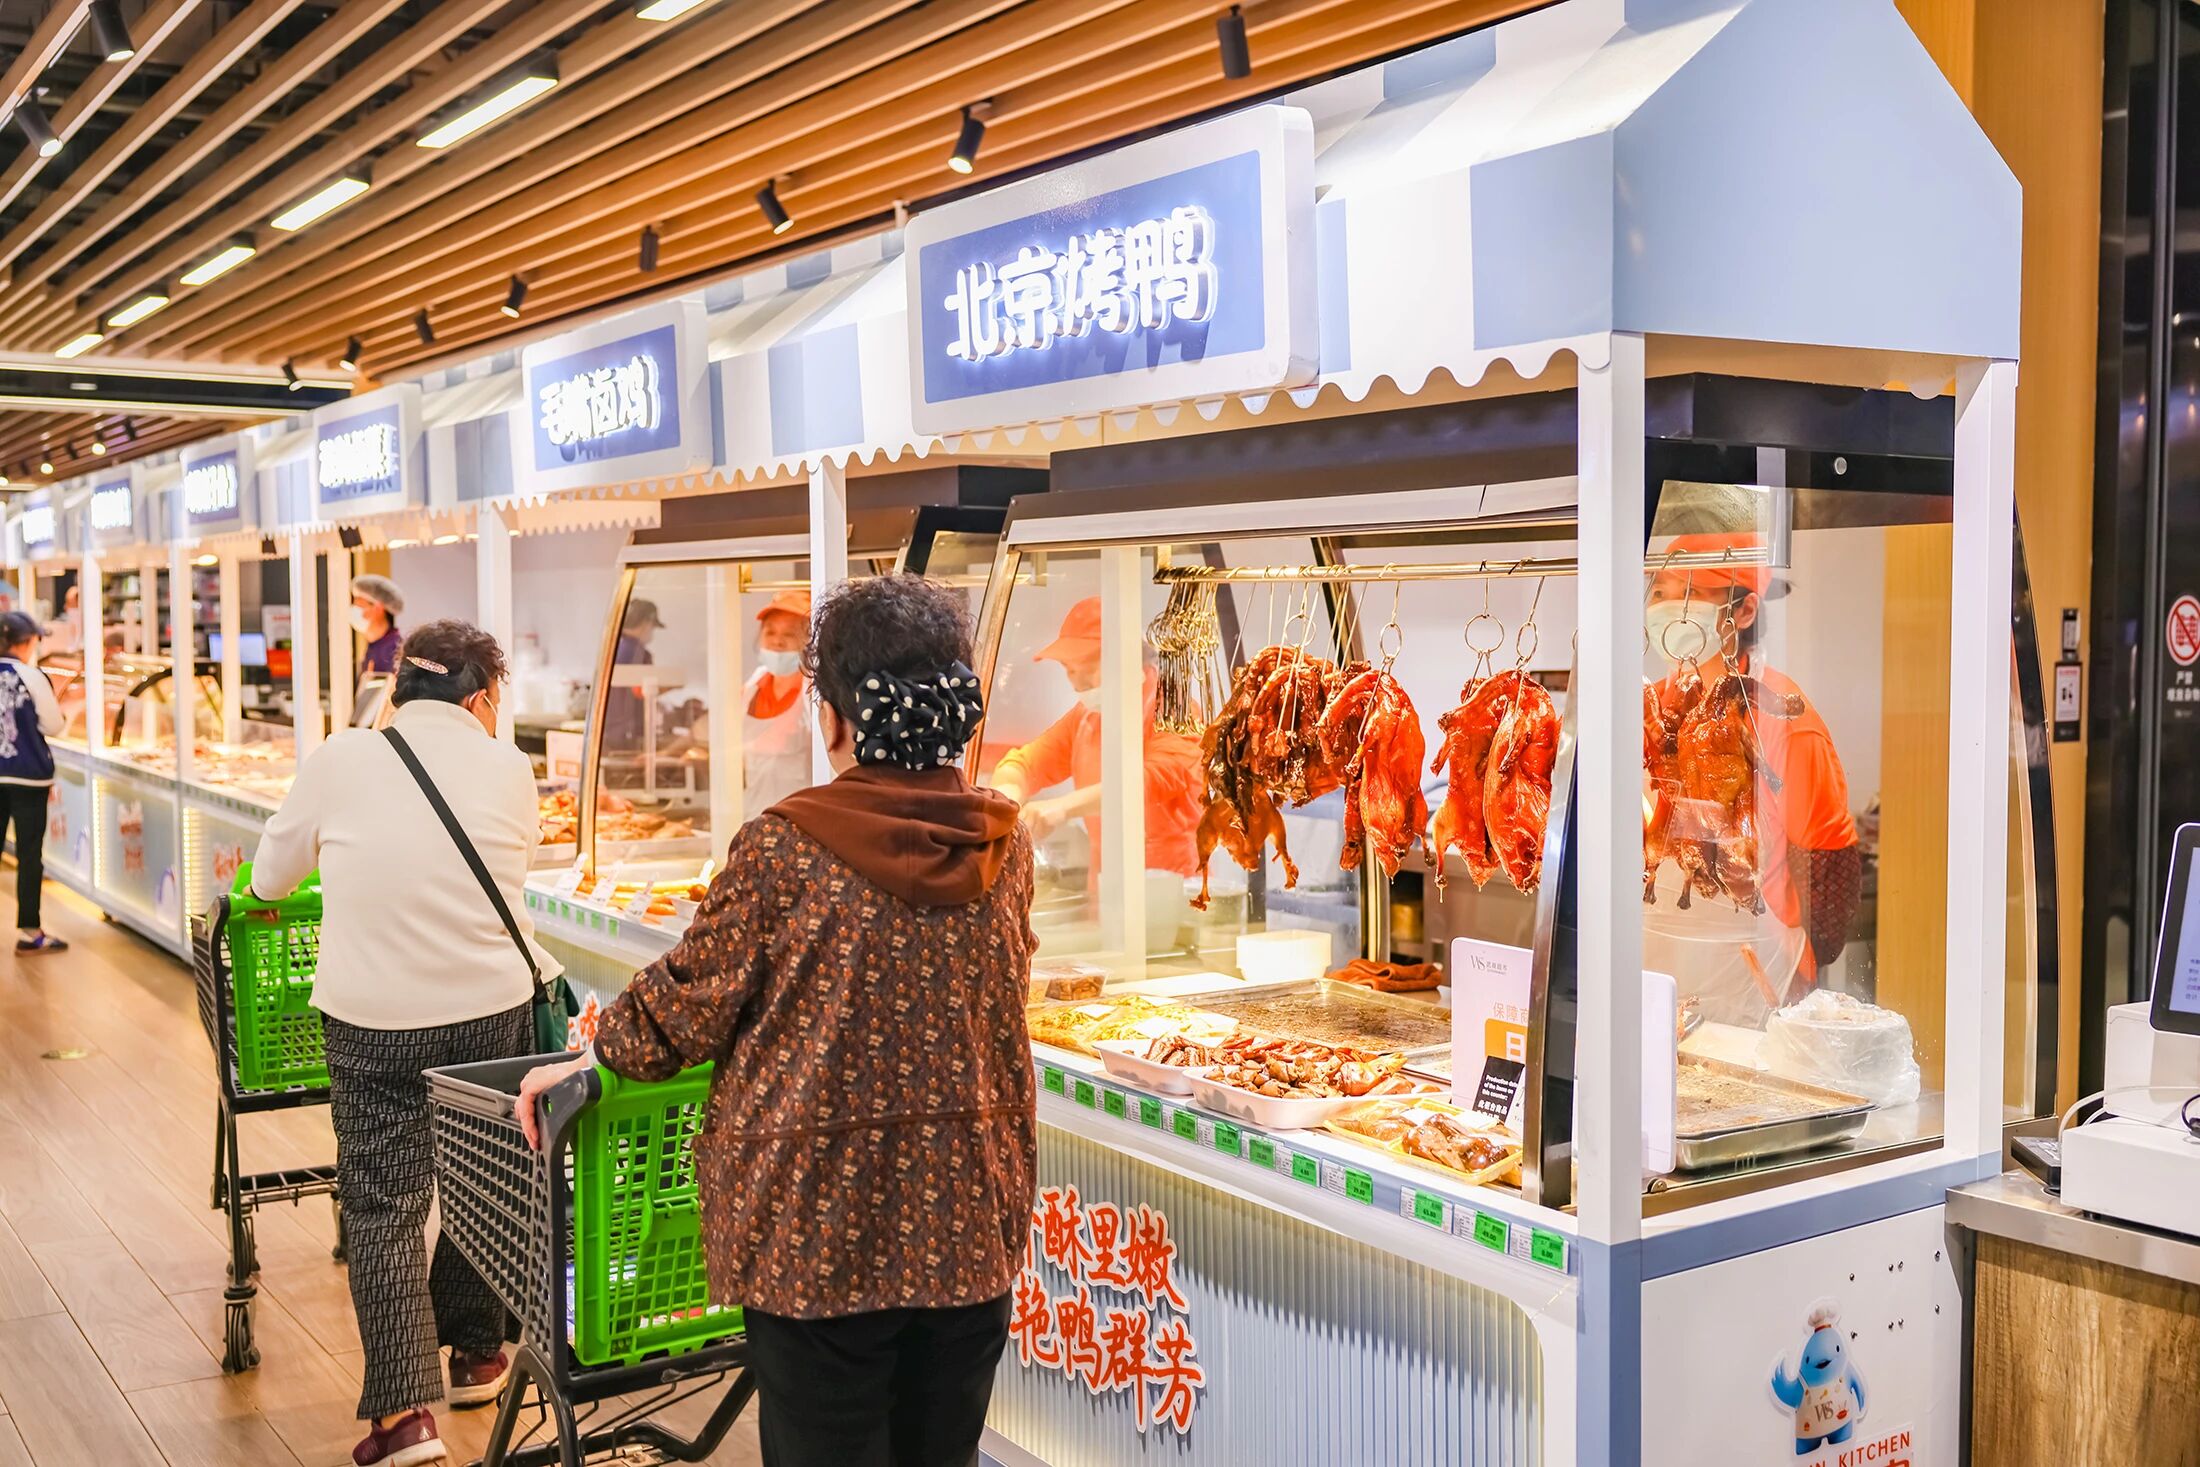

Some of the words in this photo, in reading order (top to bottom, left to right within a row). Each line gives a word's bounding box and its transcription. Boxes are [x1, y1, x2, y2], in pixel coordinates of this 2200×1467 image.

[945, 206, 1212, 361] 北京烤鸭
[1010, 1273, 1202, 1429] 艳鸭群芳
[1838, 1431, 1910, 1467] KITCHEN
